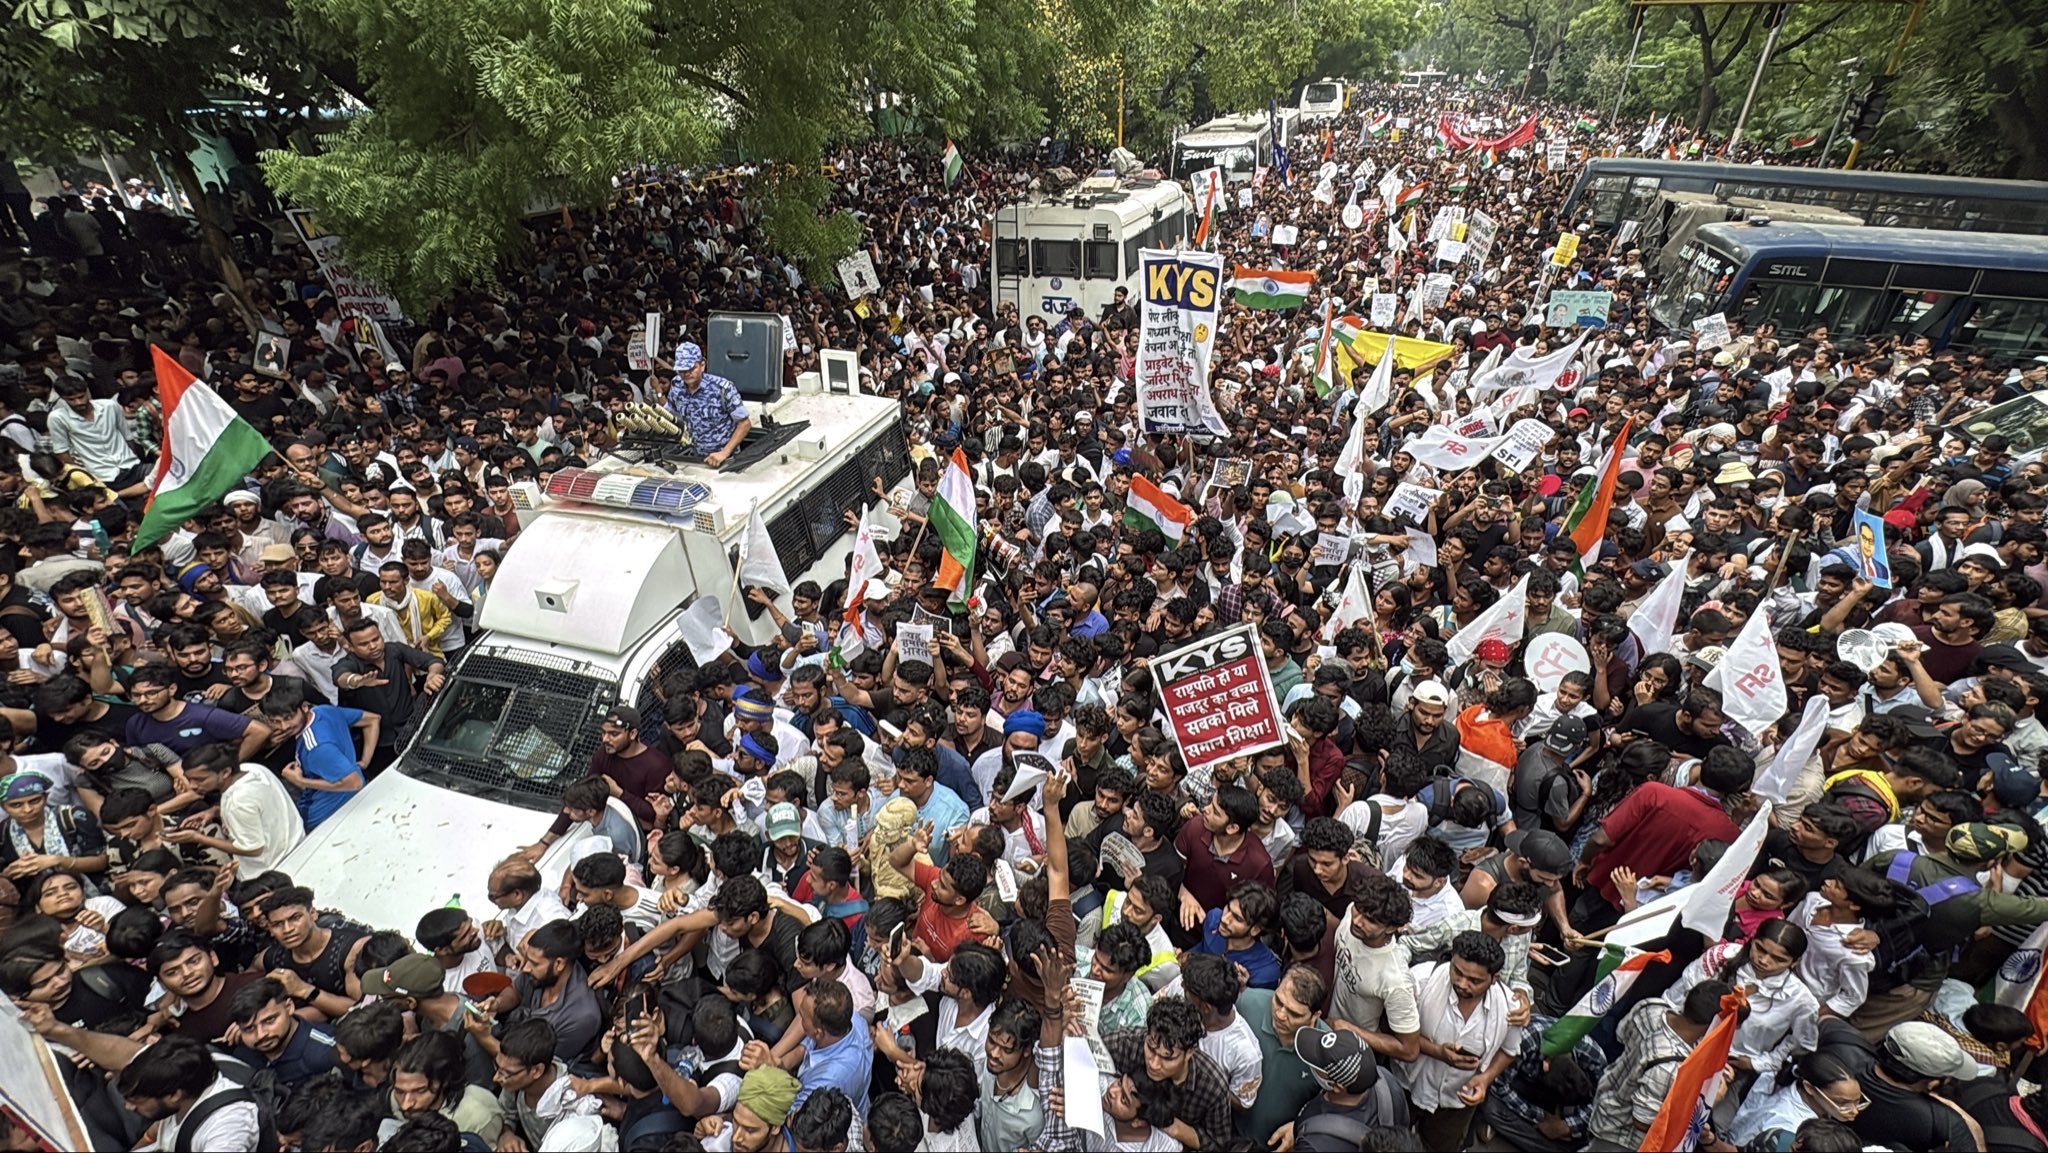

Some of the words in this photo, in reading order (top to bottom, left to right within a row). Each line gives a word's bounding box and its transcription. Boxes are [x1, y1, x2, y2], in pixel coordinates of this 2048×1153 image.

[1149, 263, 1216, 308] KYS
[1497, 448, 1522, 468] SFI
[1161, 635, 1248, 682] KYS
[1173, 676, 1216, 698] राष्ट्रपति
[1216, 669, 1231, 686] हो
[1232, 663, 1248, 677] या
[1173, 697, 1210, 716] मजदूर
[1210, 691, 1228, 704] का
[1229, 680, 1259, 697] बच्चा
[1184, 708, 1226, 735] सबको
[1227, 698, 1259, 721] मिले
[1184, 735, 1225, 758] समान
